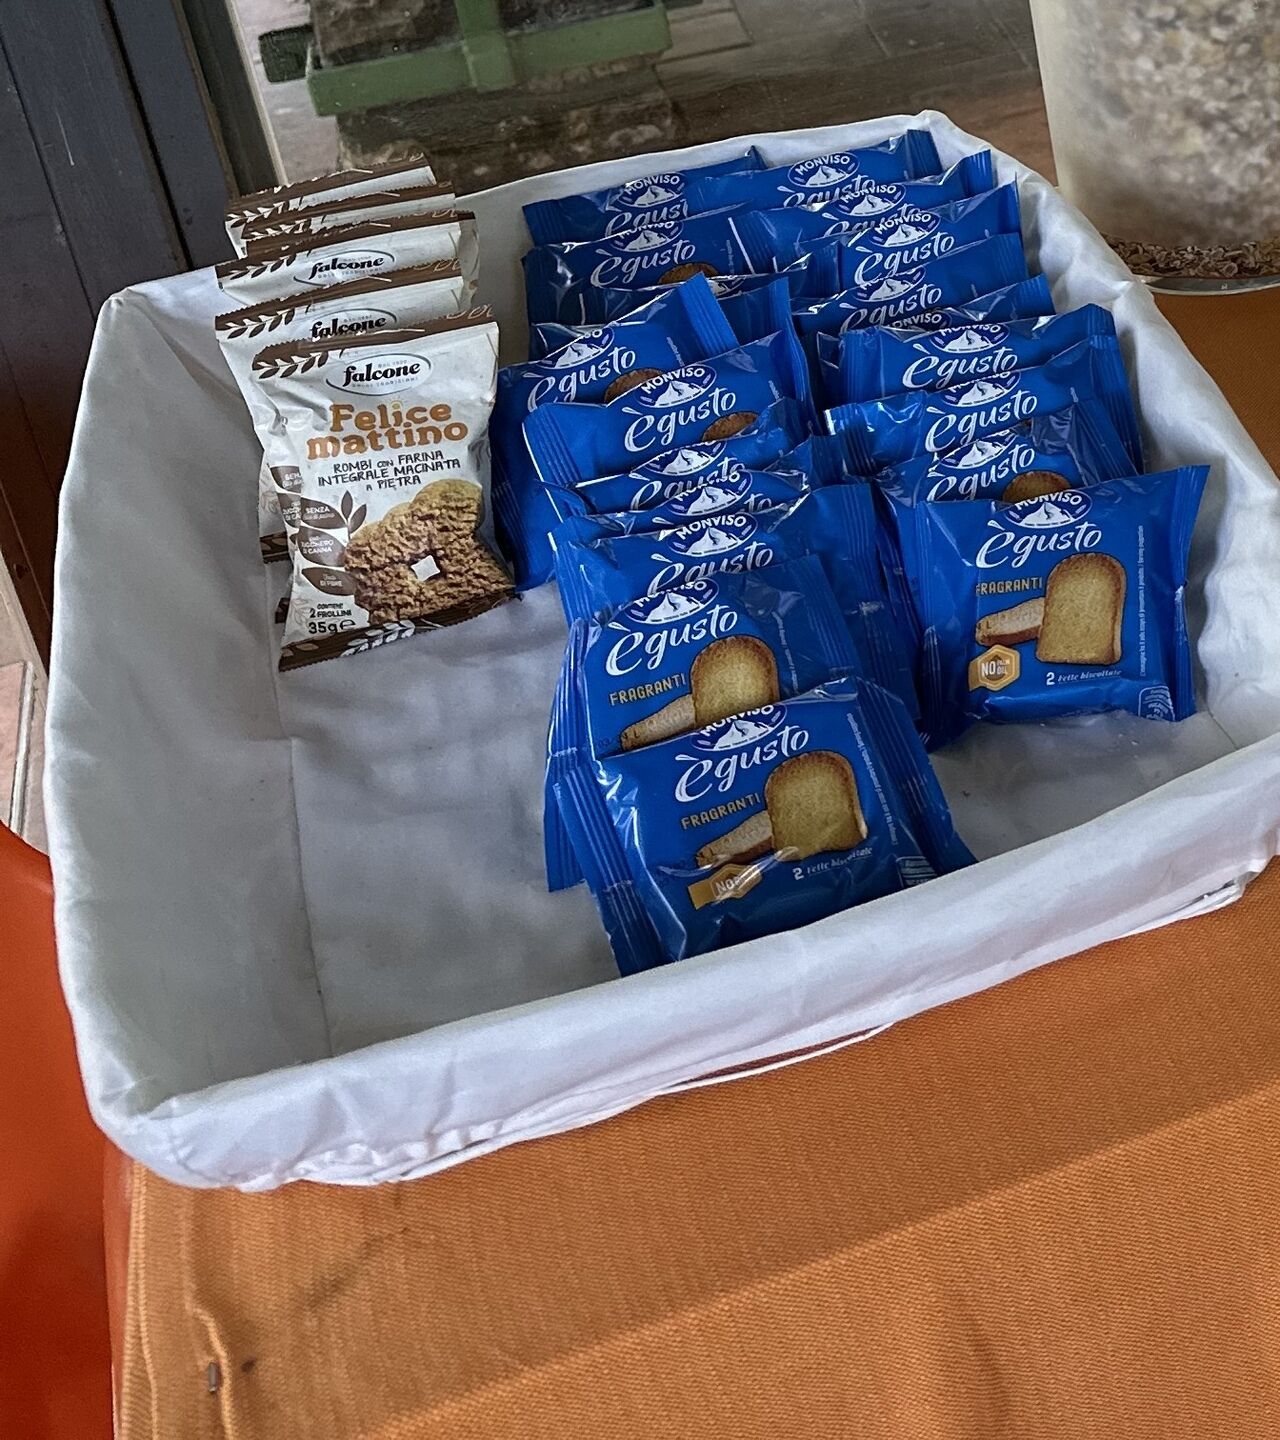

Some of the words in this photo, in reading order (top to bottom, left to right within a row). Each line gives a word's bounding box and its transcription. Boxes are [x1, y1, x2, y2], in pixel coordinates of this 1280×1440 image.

[795, 155, 851, 176] MONVISO
[624, 175, 681, 196] MONVISO
[874, 212, 932, 235] MONVISO
[308, 256, 386, 281] falcone
[590, 239, 697, 289] ègusto
[854, 231, 956, 286] ègusto
[838, 283, 943, 336] ègusto
[310, 315, 388, 343] falcone
[341, 361, 422, 388] falcone
[522, 346, 636, 412] ègusto
[640, 366, 706, 395] MONVISO
[902, 343, 1019, 390] ègusto
[328, 400, 453, 433] Felice
[621, 387, 737, 452] ègusto
[925, 390, 1038, 453] ègusto
[305, 420, 469, 460] mattino
[317, 467, 390, 487] INTEGRALE
[393, 458, 462, 477] MACINATA
[332, 460, 373, 474] ROMBI
[397, 450, 444, 466] FARINA
[927, 444, 1036, 502] ègusto
[377, 474, 422, 490] PIETRA
[305, 506, 331, 515] SENZA
[675, 515, 748, 541] MONVISO
[975, 519, 1103, 570] ègusto
[309, 607, 317, 619] 2
[605, 602, 739, 677] ègusto
[609, 672, 688, 707] FRAGRANTI
[1046, 671, 1056, 686] 2
[674, 724, 810, 803] ègusto
[680, 792, 762, 830] FRAGRANTI
[792, 866, 805, 881] 2
